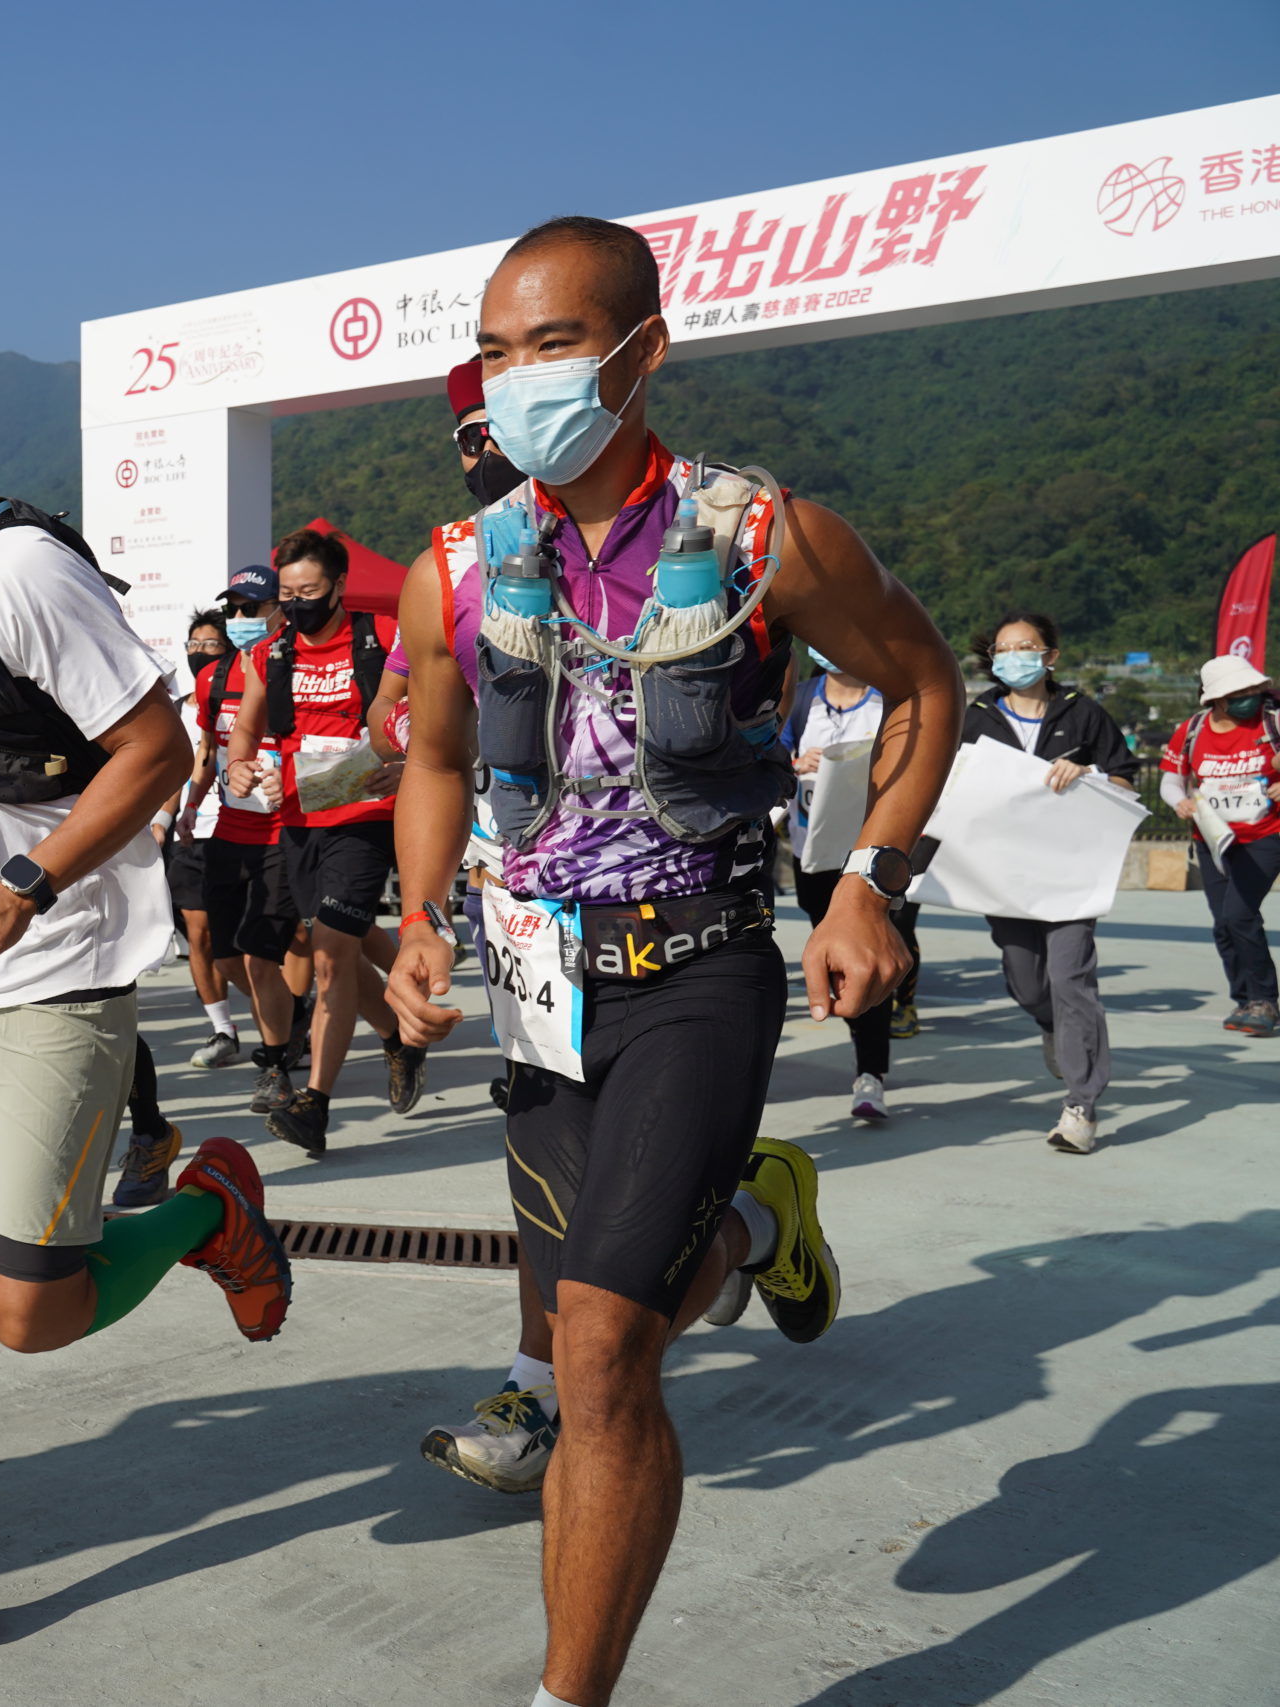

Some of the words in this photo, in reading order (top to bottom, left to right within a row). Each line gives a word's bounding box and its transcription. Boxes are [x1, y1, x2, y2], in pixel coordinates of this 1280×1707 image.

[1200, 144, 1280, 194] 香港
[1200, 205, 1234, 222] THE
[1241, 198, 1280, 215] HON
[683, 293, 823, 331] 中銀人壽慈善賽
[825, 287, 873, 309] 2022
[397, 325, 440, 349] BOC
[124, 341, 181, 396] 25
[1208, 795, 1262, 810] 017-4
[583, 910, 729, 978] aked
